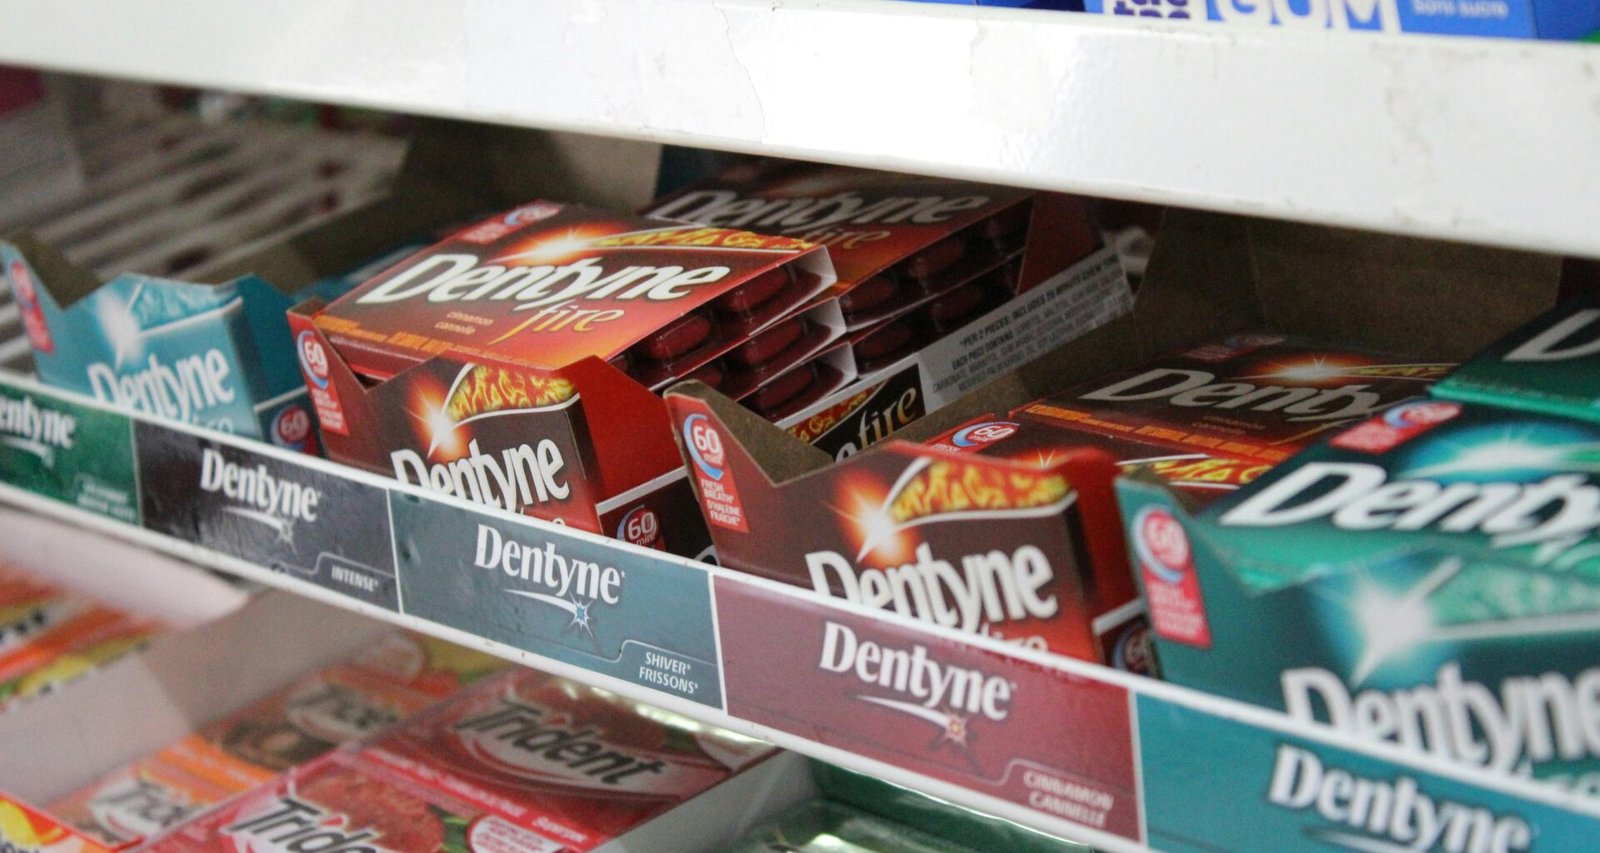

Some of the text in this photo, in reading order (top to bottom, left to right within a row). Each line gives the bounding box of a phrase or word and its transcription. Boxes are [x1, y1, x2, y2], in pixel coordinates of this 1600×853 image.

[644, 190, 993, 229] Dentyne
[356, 252, 731, 312] Dentyne
[488, 302, 625, 345] fire
[88, 348, 235, 423] Dentyne
[858, 387, 918, 449] fire
[1080, 368, 1381, 423] Denty
[0, 395, 76, 449] entyne
[693, 426, 722, 455] 60
[200, 449, 319, 522] Dentyne
[391, 437, 570, 514] Dentyne
[1217, 462, 1600, 550] Denty
[628, 512, 657, 540] 60
[474, 524, 624, 604] Dentyne
[805, 542, 1058, 636] Dentyne
[819, 621, 1014, 720] Dentyne
[450, 700, 668, 785] Trident
[227, 797, 378, 853] Trid
[1268, 743, 1533, 853] Dentyne
